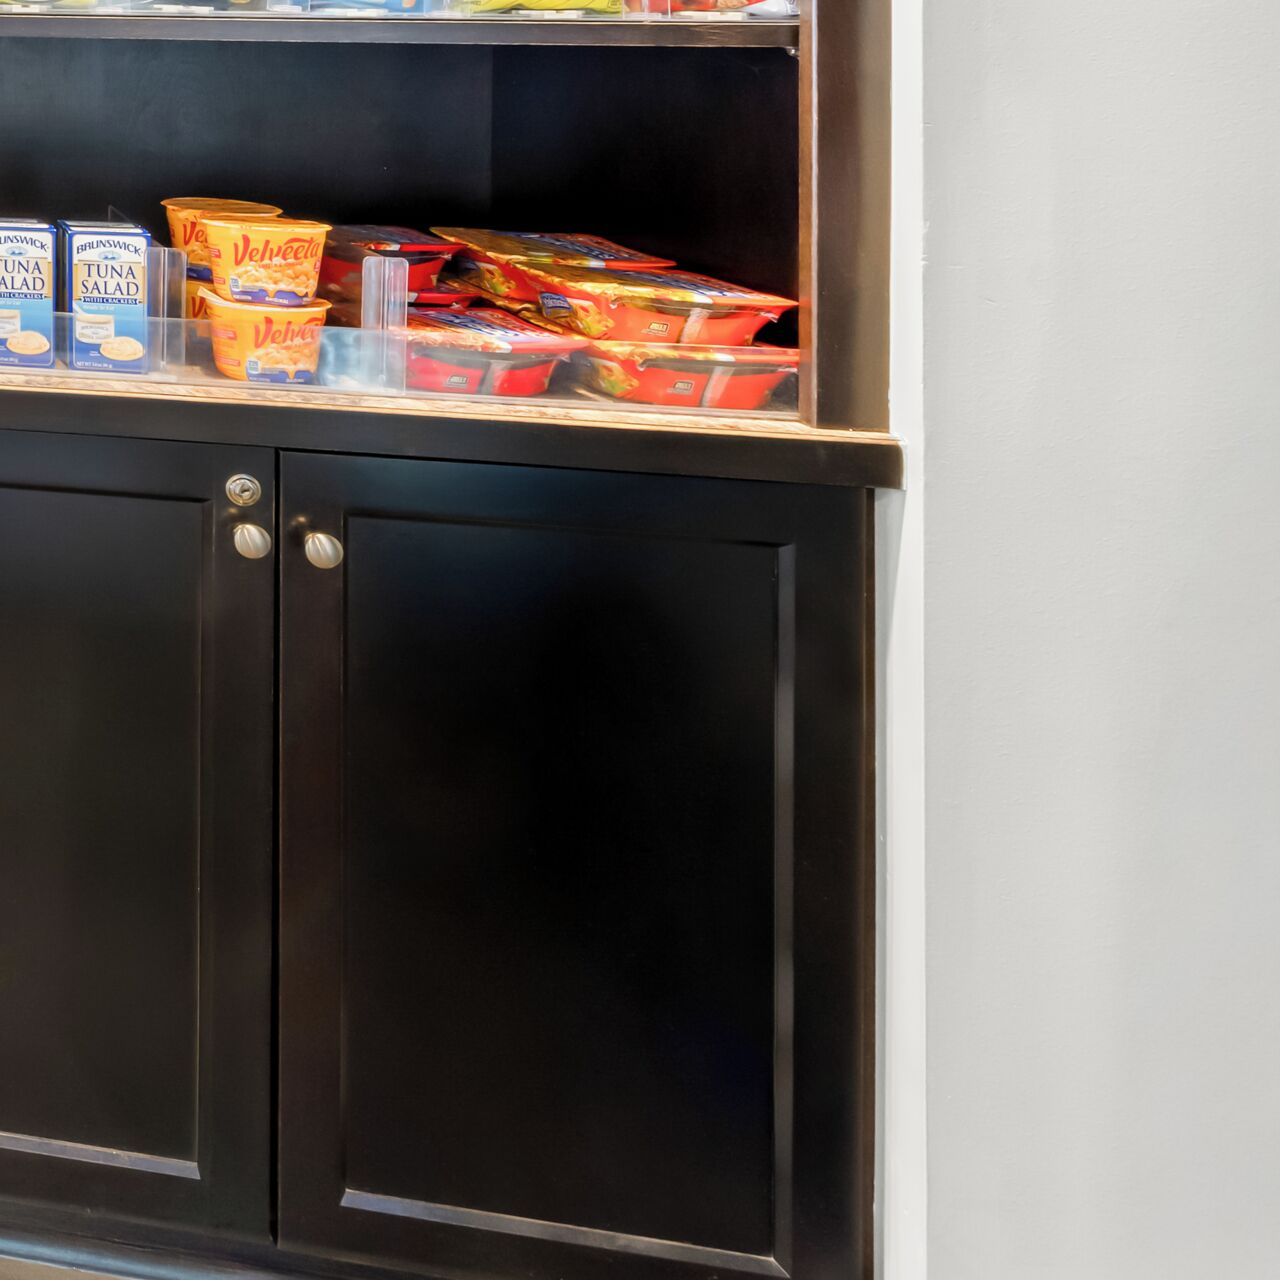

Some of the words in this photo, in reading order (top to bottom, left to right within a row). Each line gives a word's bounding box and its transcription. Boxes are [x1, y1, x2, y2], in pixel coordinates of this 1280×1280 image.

[76, 239, 141, 256] BRUNSWICK
[233, 234, 322, 266] Velveeta
[83, 263, 137, 279] TUNA
[81, 280, 139, 296] SALAD
[103, 297, 136, 305] CRACKERS
